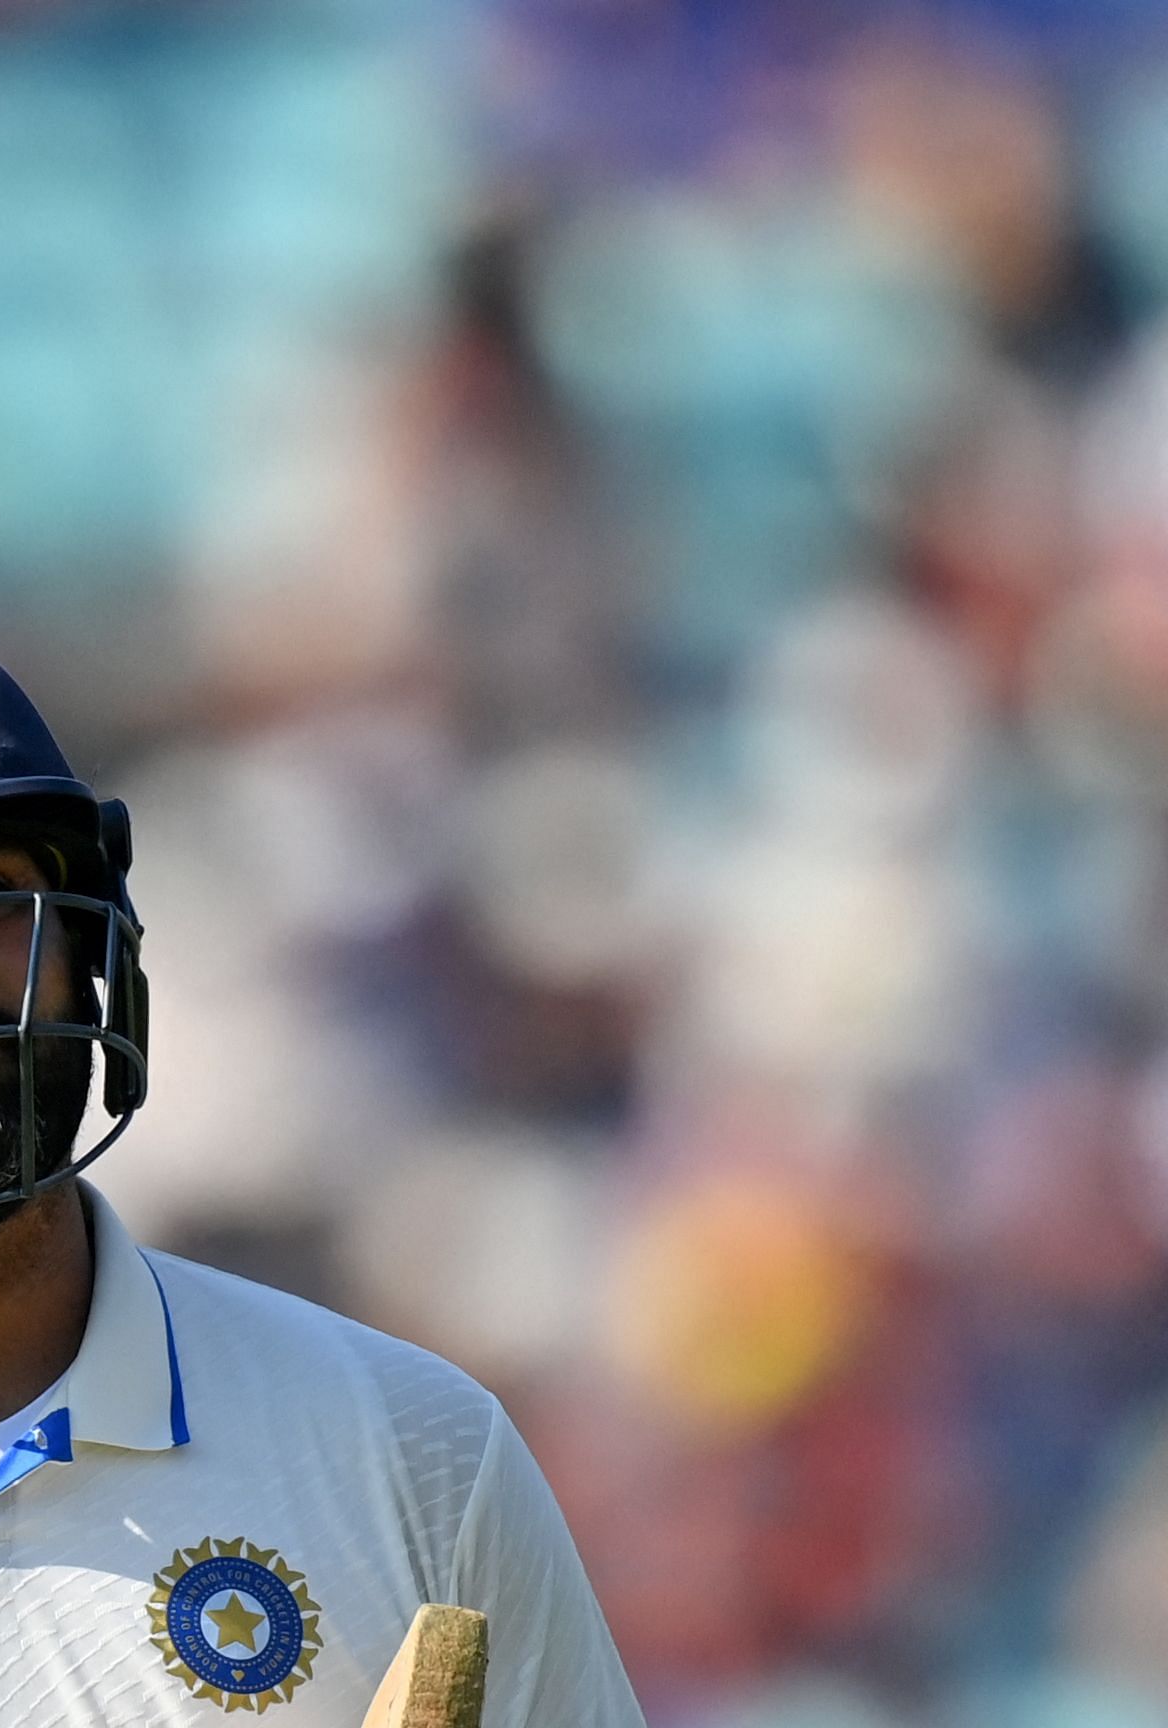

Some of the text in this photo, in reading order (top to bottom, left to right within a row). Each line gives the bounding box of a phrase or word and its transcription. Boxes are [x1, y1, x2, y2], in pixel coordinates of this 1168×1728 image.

[181, 1569, 290, 1676] BOARD OF CONTROL FOR CRICKET IN INDIA
